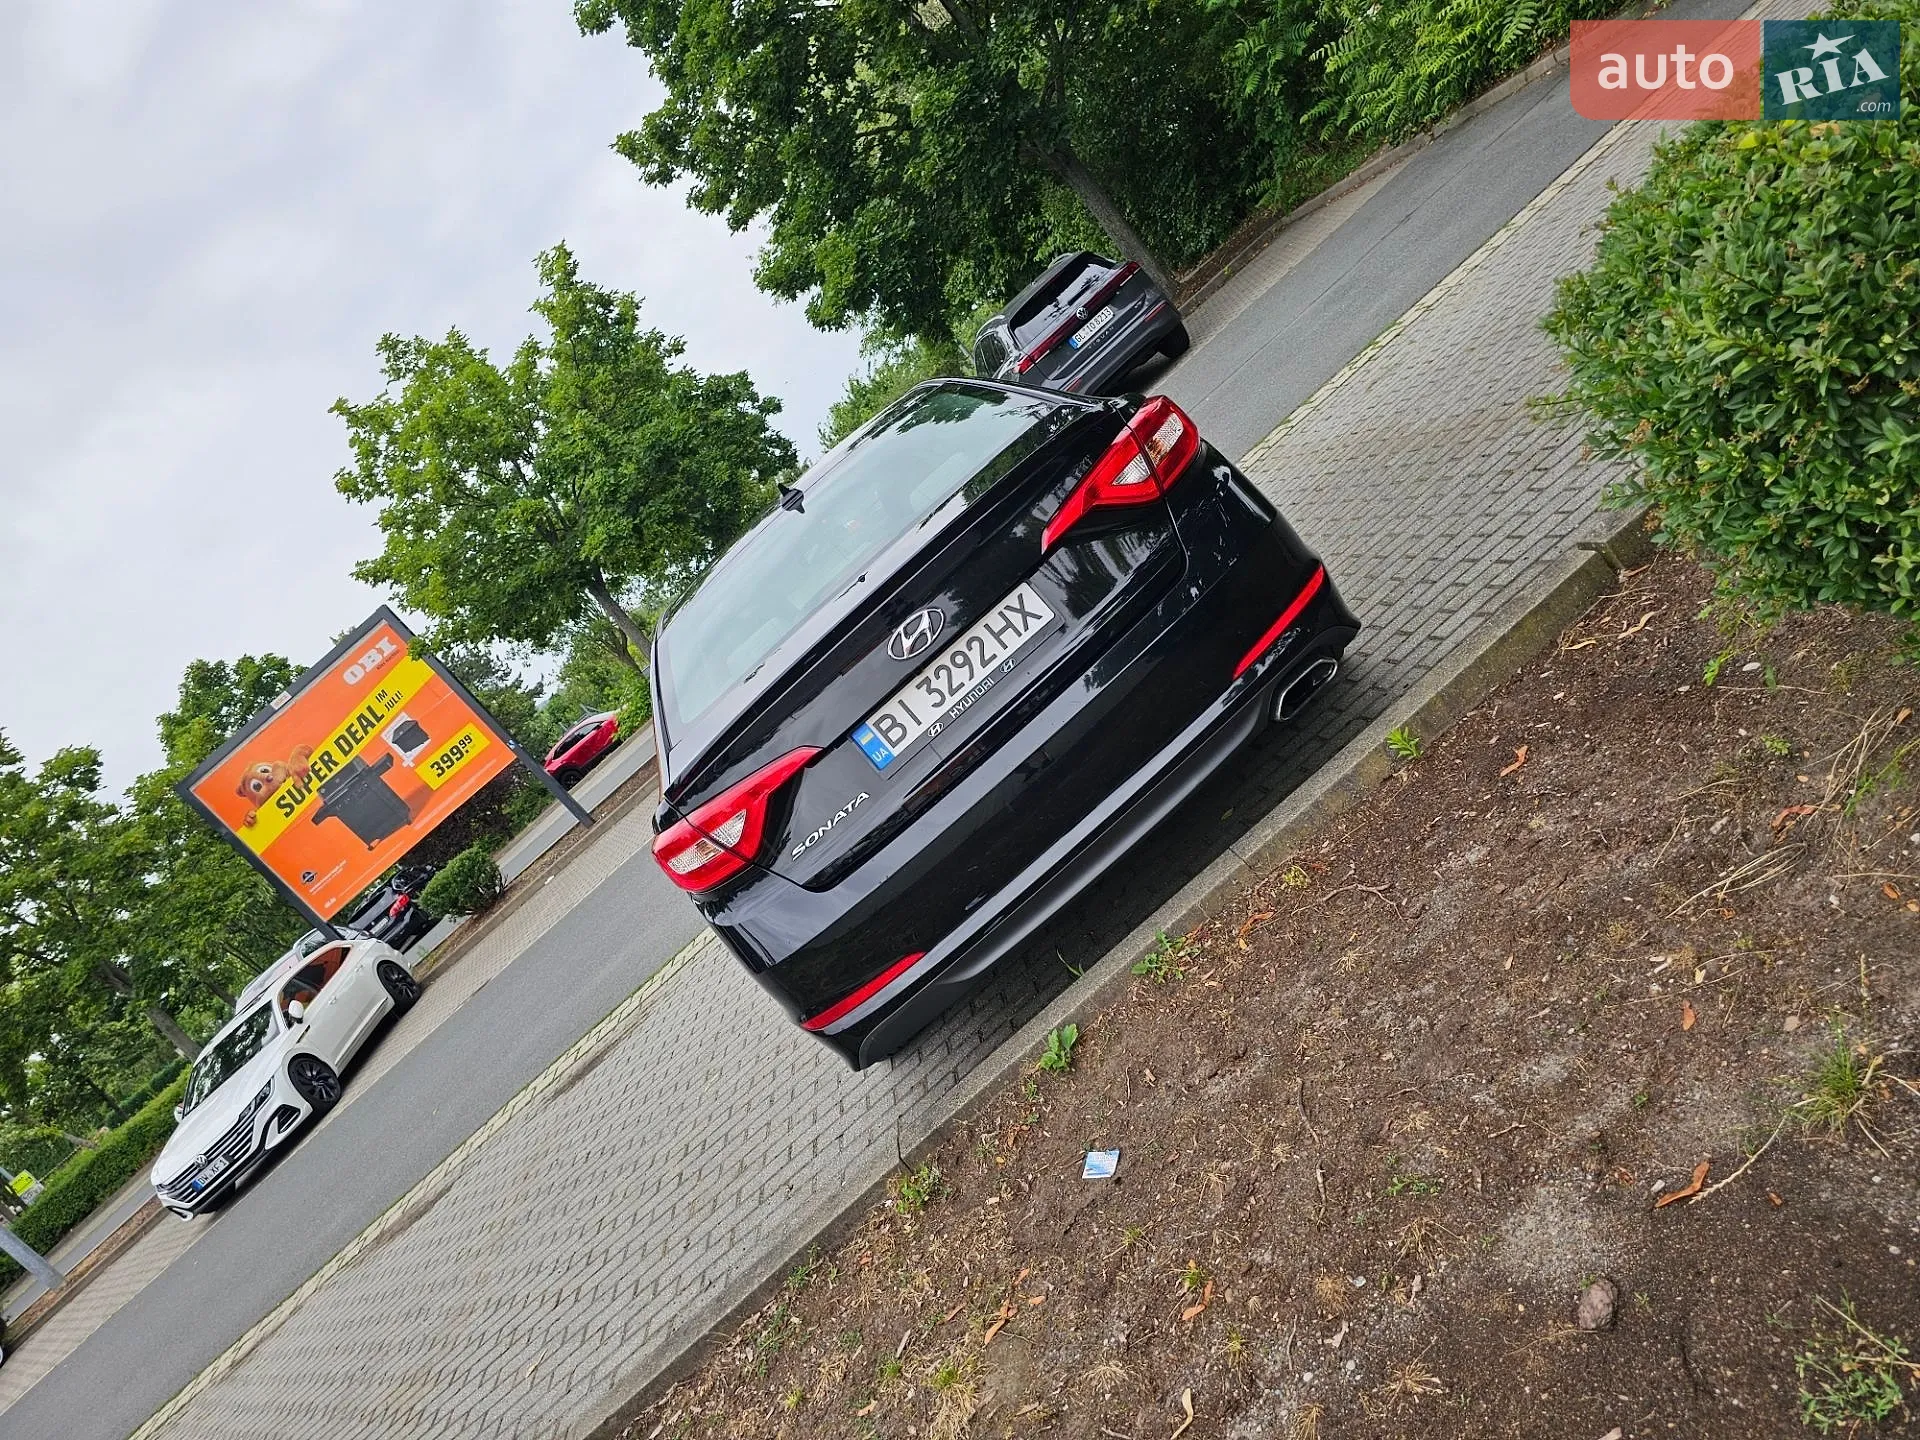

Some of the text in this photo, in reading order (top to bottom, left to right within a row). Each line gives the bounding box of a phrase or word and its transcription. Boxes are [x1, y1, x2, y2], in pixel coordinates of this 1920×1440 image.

[343, 636, 398, 686] OBI
[873, 593, 1043, 748] BI 3292 HX
[375, 689, 389, 704] IM
[384, 691, 404, 712] JULI!
[949, 677, 995, 719] HYUNDAI
[276, 750, 340, 818] SUPER
[333, 704, 385, 758] DEAL
[872, 748, 889, 762] UA
[791, 792, 870, 861] SONATA
